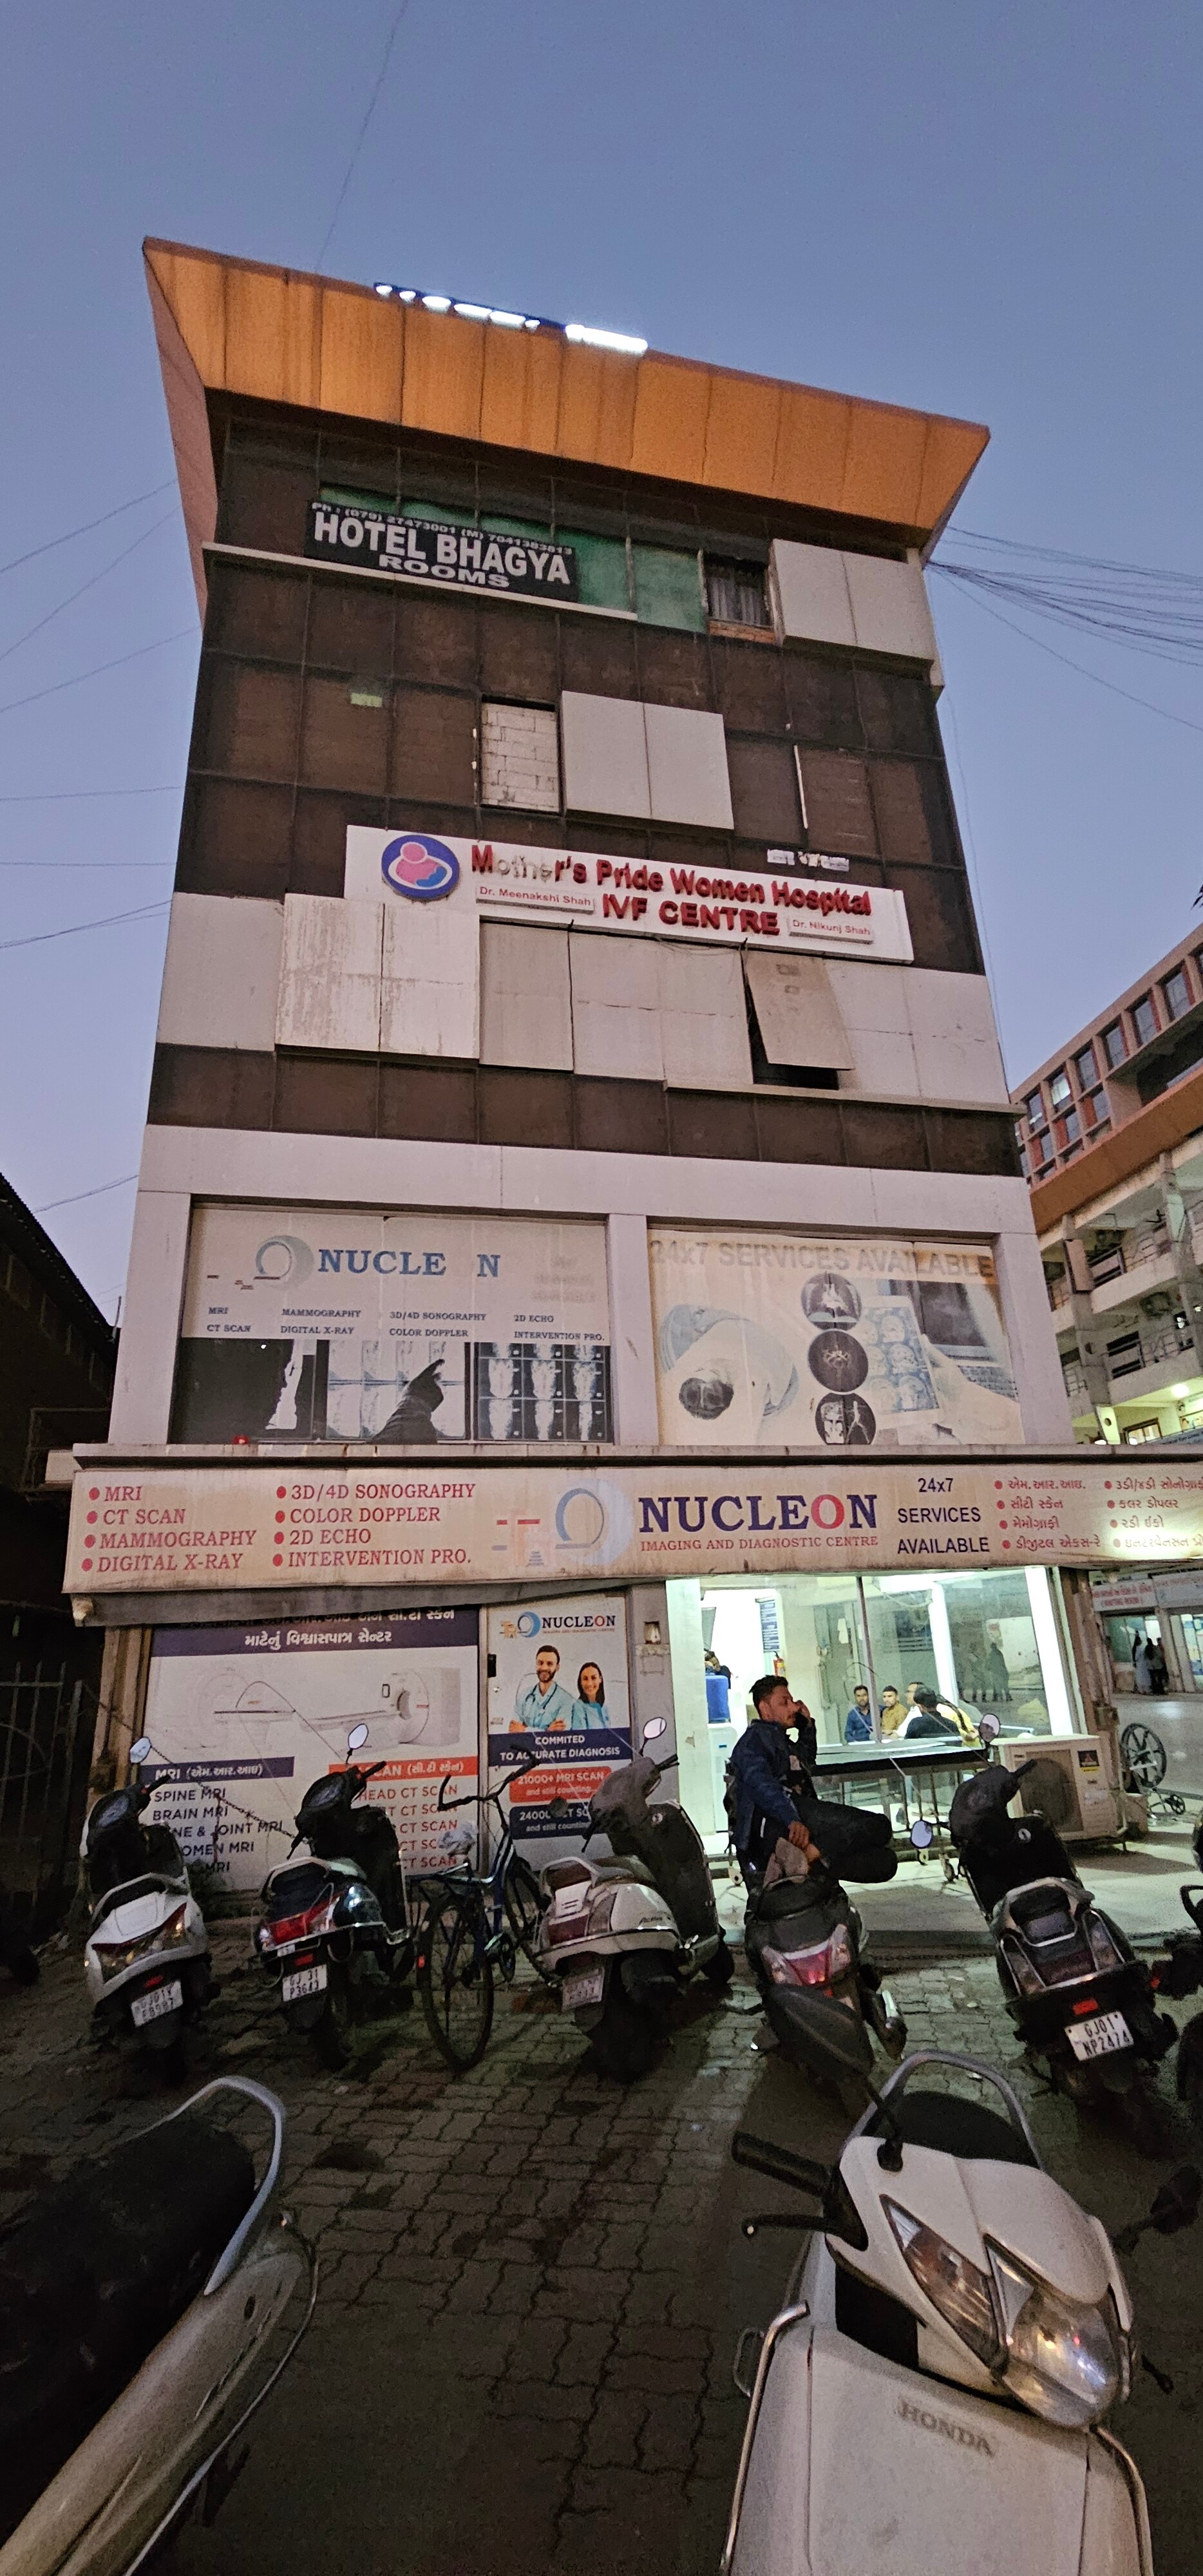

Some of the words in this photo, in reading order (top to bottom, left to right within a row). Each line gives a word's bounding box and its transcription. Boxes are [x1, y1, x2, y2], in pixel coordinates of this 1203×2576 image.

[461, 528, 483, 540] (M)
[314, 511, 426, 560] HOTEL
[437, 533, 571, 585] BHAGYA
[379, 554, 510, 587] ROOMS
[596, 859, 663, 892] Pride
[670, 867, 765, 904] Women
[772, 880, 871, 916] Hospital
[479, 886, 495, 896] Dr.
[499, 888, 560, 902] Meenakshi
[563, 895, 591, 906] Shah
[603, 893, 648, 921] IVF
[659, 900, 780, 935] CENTRE
[793, 920, 807, 928] Dr.
[810, 922, 842, 934] Nikunj
[845, 925, 871, 935] Shah
[650, 1240, 709, 1266] 24x7
[718, 1242, 849, 1271] SERVICES
[856, 1244, 994, 1279] AVAILABLE
[208, 1307, 229, 1315] MRI
[282, 1308, 361, 1318] MAMMOGRAPHY
[390, 1311, 420, 1320] 3D/4D
[422, 1311, 486, 1321] SONOGRAPHY
[529, 1314, 554, 1323] ECHO
[281, 1325, 321, 1334] DIGITAL
[324, 1327, 355, 1335] X-RAY
[389, 1328, 422, 1336] COLOR
[425, 1329, 468, 1337] DOPPLER
[514, 1331, 580, 1340] INTERVENTION
[291, 1484, 350, 1502] 3D/4D
[355, 1483, 476, 1499] SONOGRAPHY
[918, 1478, 953, 1493] 24x7
[104, 1486, 142, 1502] MRI
[1038, 1495, 1063, 1509] સ્કેન
[1119, 1499, 1142, 1509] કલર
[103, 1510, 131, 1525] CT
[135, 1509, 185, 1524] SCAN
[290, 1508, 353, 1524] COLOR
[359, 1507, 440, 1522] DOPPLER
[638, 1494, 877, 1533] NUCLEON
[898, 1506, 981, 1524] SERVICES
[99, 1530, 257, 1549] MAMMOGRAPHY
[289, 1530, 314, 1545] 2D
[320, 1528, 372, 1544] ECHO
[641, 1540, 701, 1552] IMAGING
[706, 1539, 734, 1550] AND
[740, 1537, 821, 1550] DIAGNOSTIC
[826, 1535, 878, 1547] CENTRE
[897, 1537, 990, 1555] AVAILABLE
[97, 1553, 178, 1573] DIGITAL
[184, 1553, 243, 1570] X-RAY
[287, 1549, 425, 1567] INTERVENTION
[430, 1548, 471, 1564] PRO.
[542, 1615, 616, 1629] NUCLEON
[244, 1630, 281, 1651] માટેનું
[358, 1627, 393, 1643] સેન્ટર
[535, 1735, 585, 1745] COMMITED
[500, 1752, 515, 1761] TO
[516, 1749, 567, 1761] ACURATE
[569, 1747, 620, 1758] DIAGNOSIS
[155, 1768, 180, 1781] MRI
[556, 1773, 575, 1783] MRI
[576, 1770, 605, 1781] SCAN
[155, 1789, 196, 1802] SPINE
[201, 1788, 226, 1801] MRI
[359, 1788, 396, 1802] HEAD
[401, 1786, 418, 1799] CT
[153, 1808, 198, 1821] BRAIN
[203, 1806, 228, 1818] MRI
[401, 1805, 417, 1817] CT
[196, 1826, 205, 1836] &
[258, 1820, 283, 1833] MRI
[400, 1822, 417, 1834] CT
[421, 1820, 458, 1832] SCAN
[526, 1824, 541, 1832] and
[229, 1841, 254, 1854] MRI
[400, 1840, 417, 1852] CT
[421, 1838, 438, 1850] SC
[421, 1855, 457, 1868] SCAN
[1084, 2016, 1115, 2038] GJ01
[895, 2398, 996, 2458] HONDA
